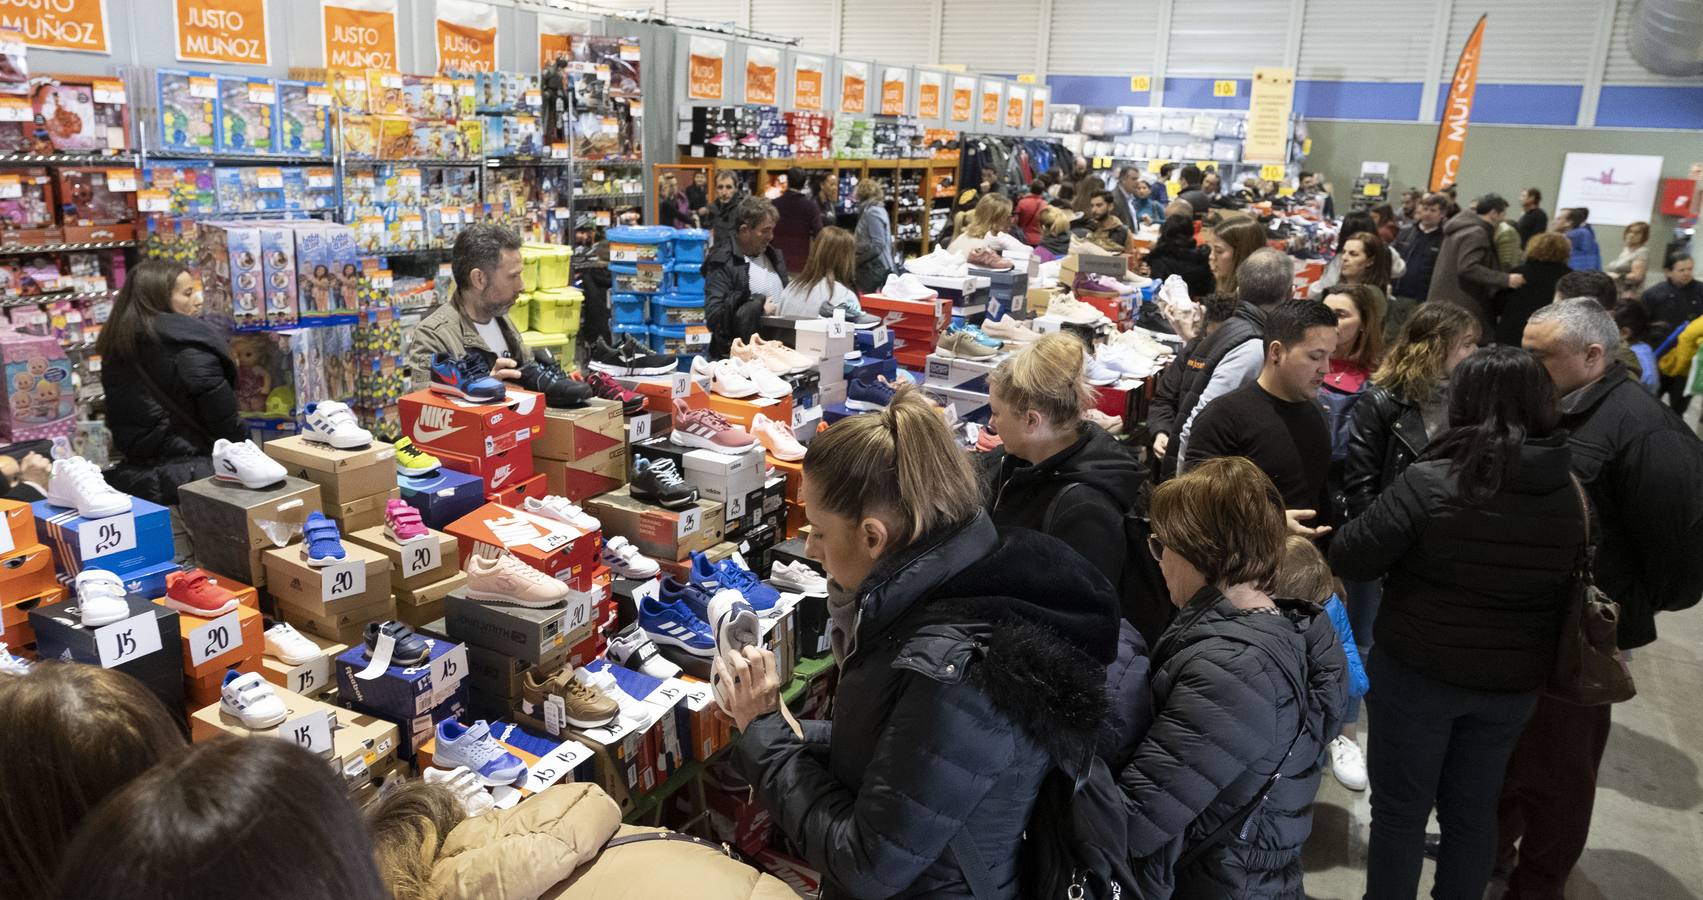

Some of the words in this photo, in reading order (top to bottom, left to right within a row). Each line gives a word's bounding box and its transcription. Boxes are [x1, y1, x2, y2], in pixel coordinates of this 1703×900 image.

[3, 13, 97, 44] MUÑOZ
[185, 7, 244, 31] JUSTO
[186, 32, 261, 59] MUÑOZ
[332, 24, 379, 45] JUSTO
[443, 33, 481, 54] JUSTO
[332, 46, 392, 69] MUÑOZ
[420, 404, 455, 430] NIKE
[636, 421, 646, 436] 60
[95, 523, 122, 555] 25
[411, 547, 431, 571] 20
[331, 570, 353, 595] 20
[569, 603, 584, 629] 20
[112, 628, 136, 661] 15
[204, 625, 229, 657] 20
[440, 657, 457, 683] 15
[297, 675, 315, 694] 15
[659, 688, 680, 700] 15
[294, 724, 312, 750] 15
[555, 751, 577, 763] 15
[532, 768, 556, 785] 15
